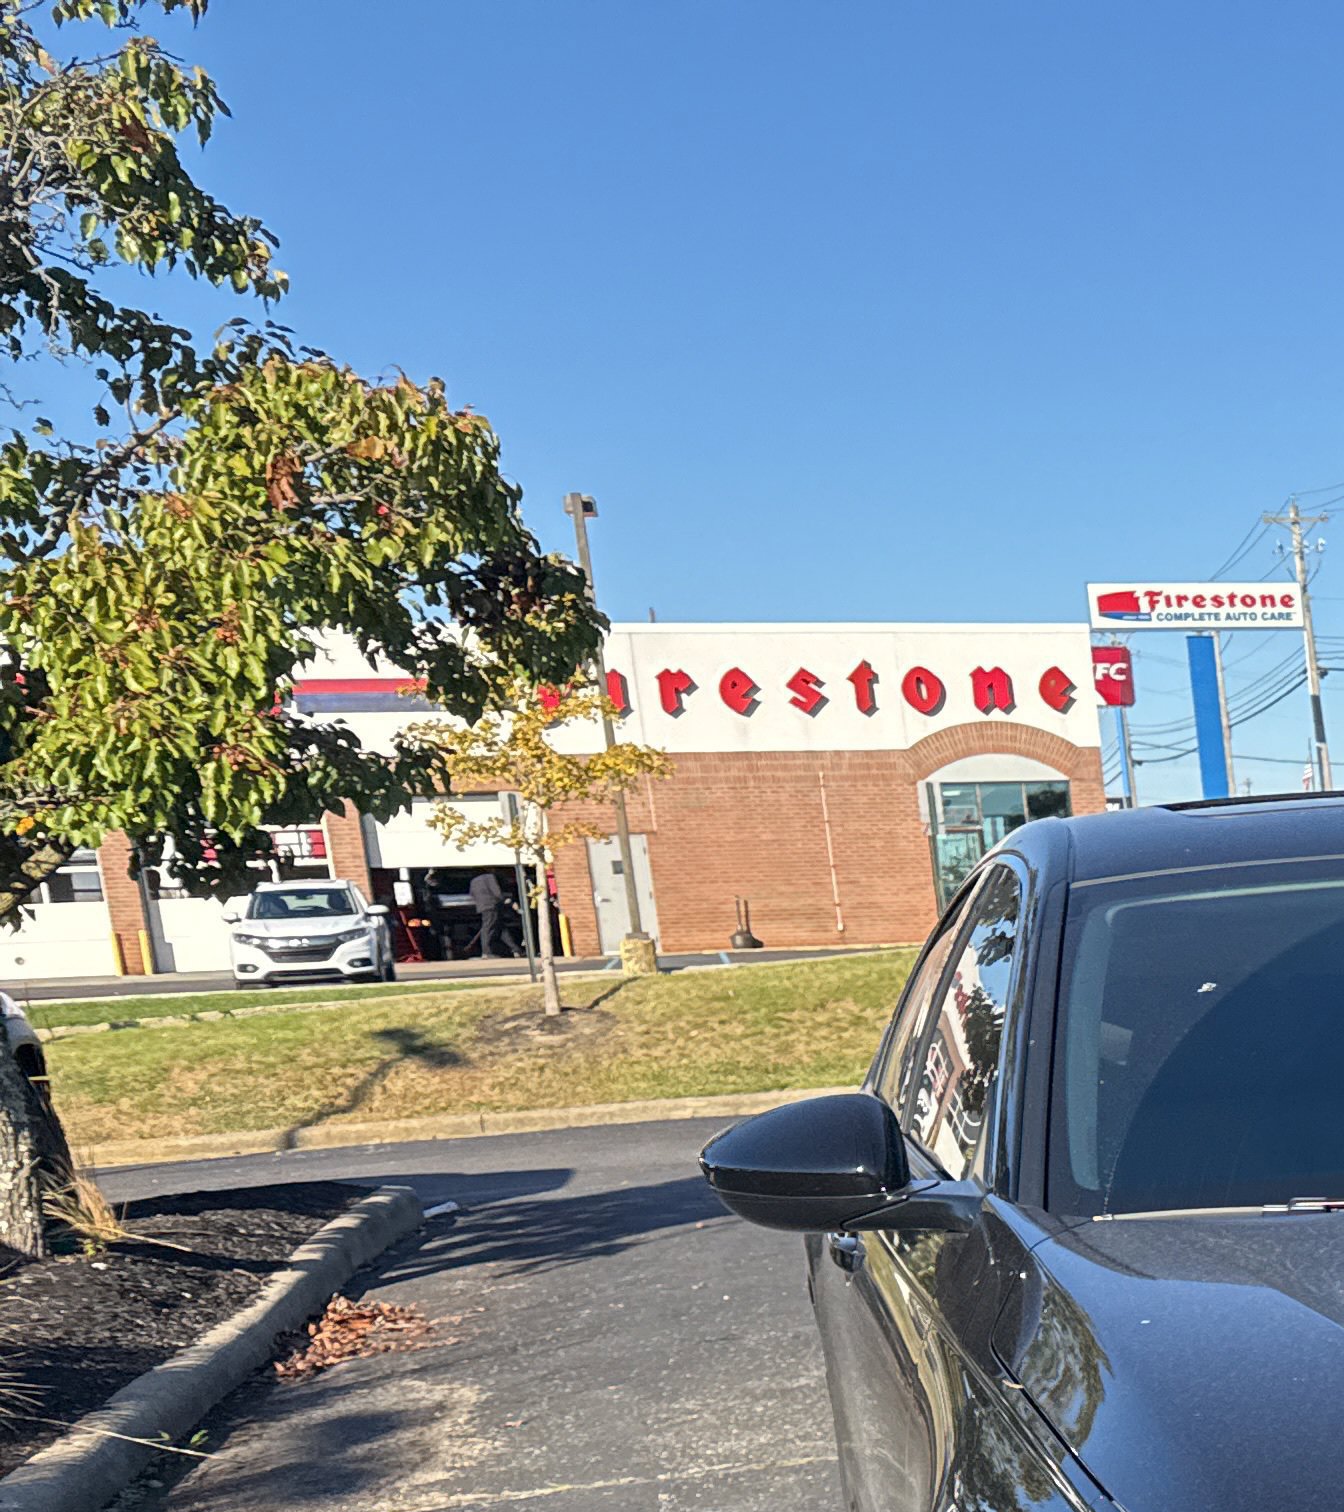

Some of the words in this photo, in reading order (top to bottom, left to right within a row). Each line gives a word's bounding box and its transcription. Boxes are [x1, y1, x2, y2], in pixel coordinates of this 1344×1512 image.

[1143, 590, 1296, 613] Firestone
[1156, 612, 1222, 622] COMPLETE
[1225, 612, 1258, 621] AUTO
[1261, 611, 1294, 621] CARE
[1092, 662, 1128, 681] FC
